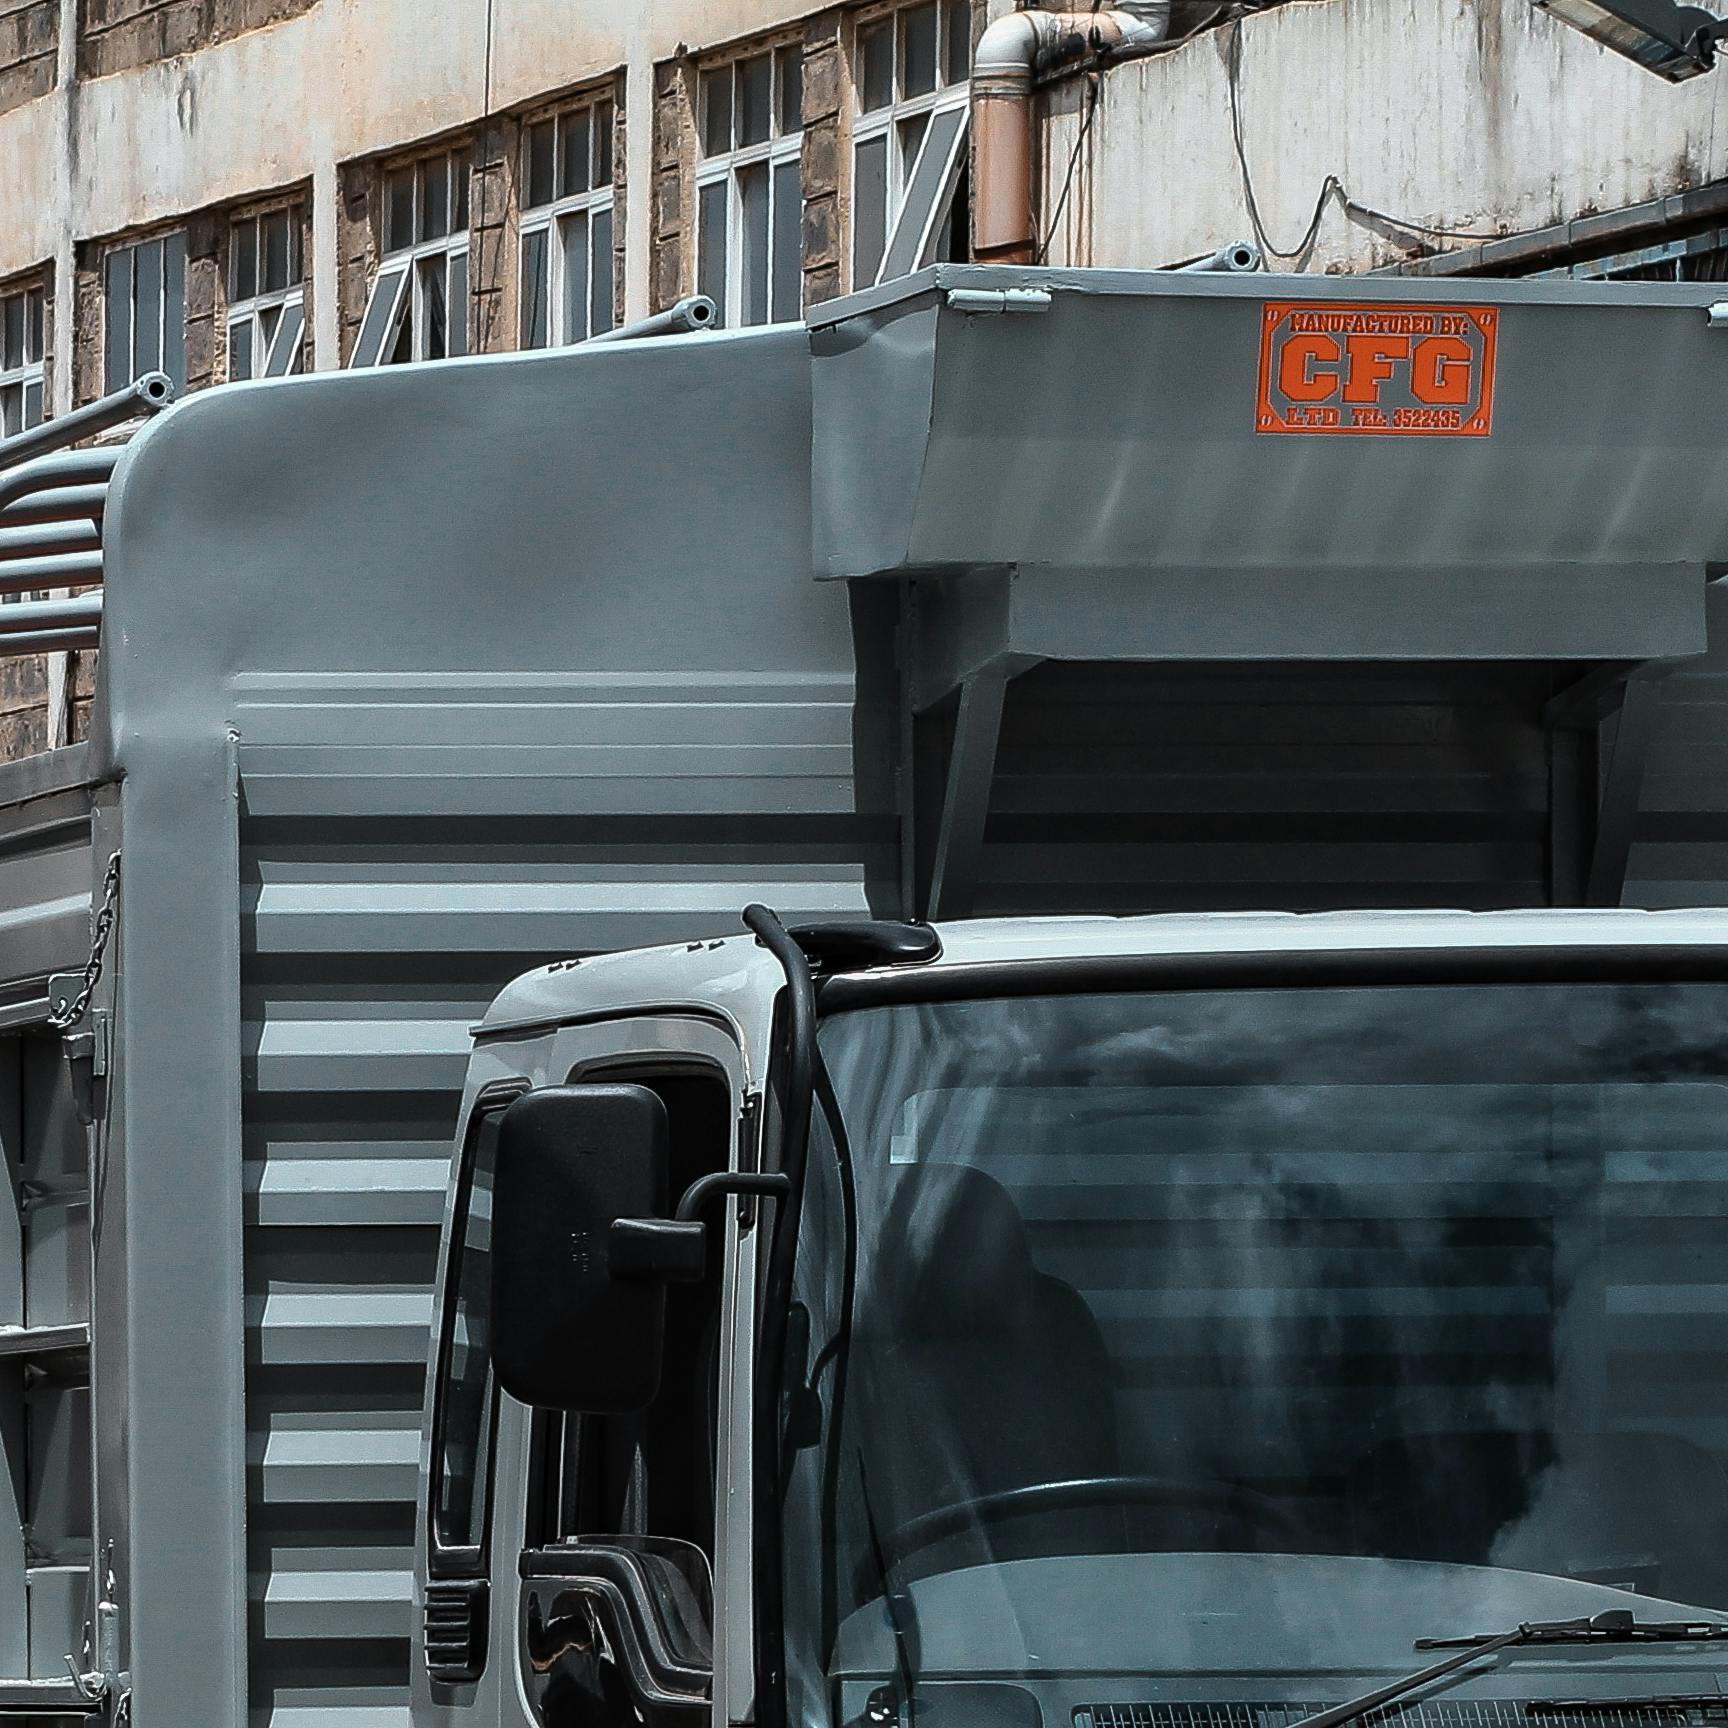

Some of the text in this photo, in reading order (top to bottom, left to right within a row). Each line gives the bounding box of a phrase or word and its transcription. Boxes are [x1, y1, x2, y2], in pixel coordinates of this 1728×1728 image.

[1289, 313, 1434, 333] MANUFACTURED
[1278, 333, 1473, 405] CFG
[1285, 406, 1340, 427] LTD
[1392, 409, 1461, 430] 3522435
